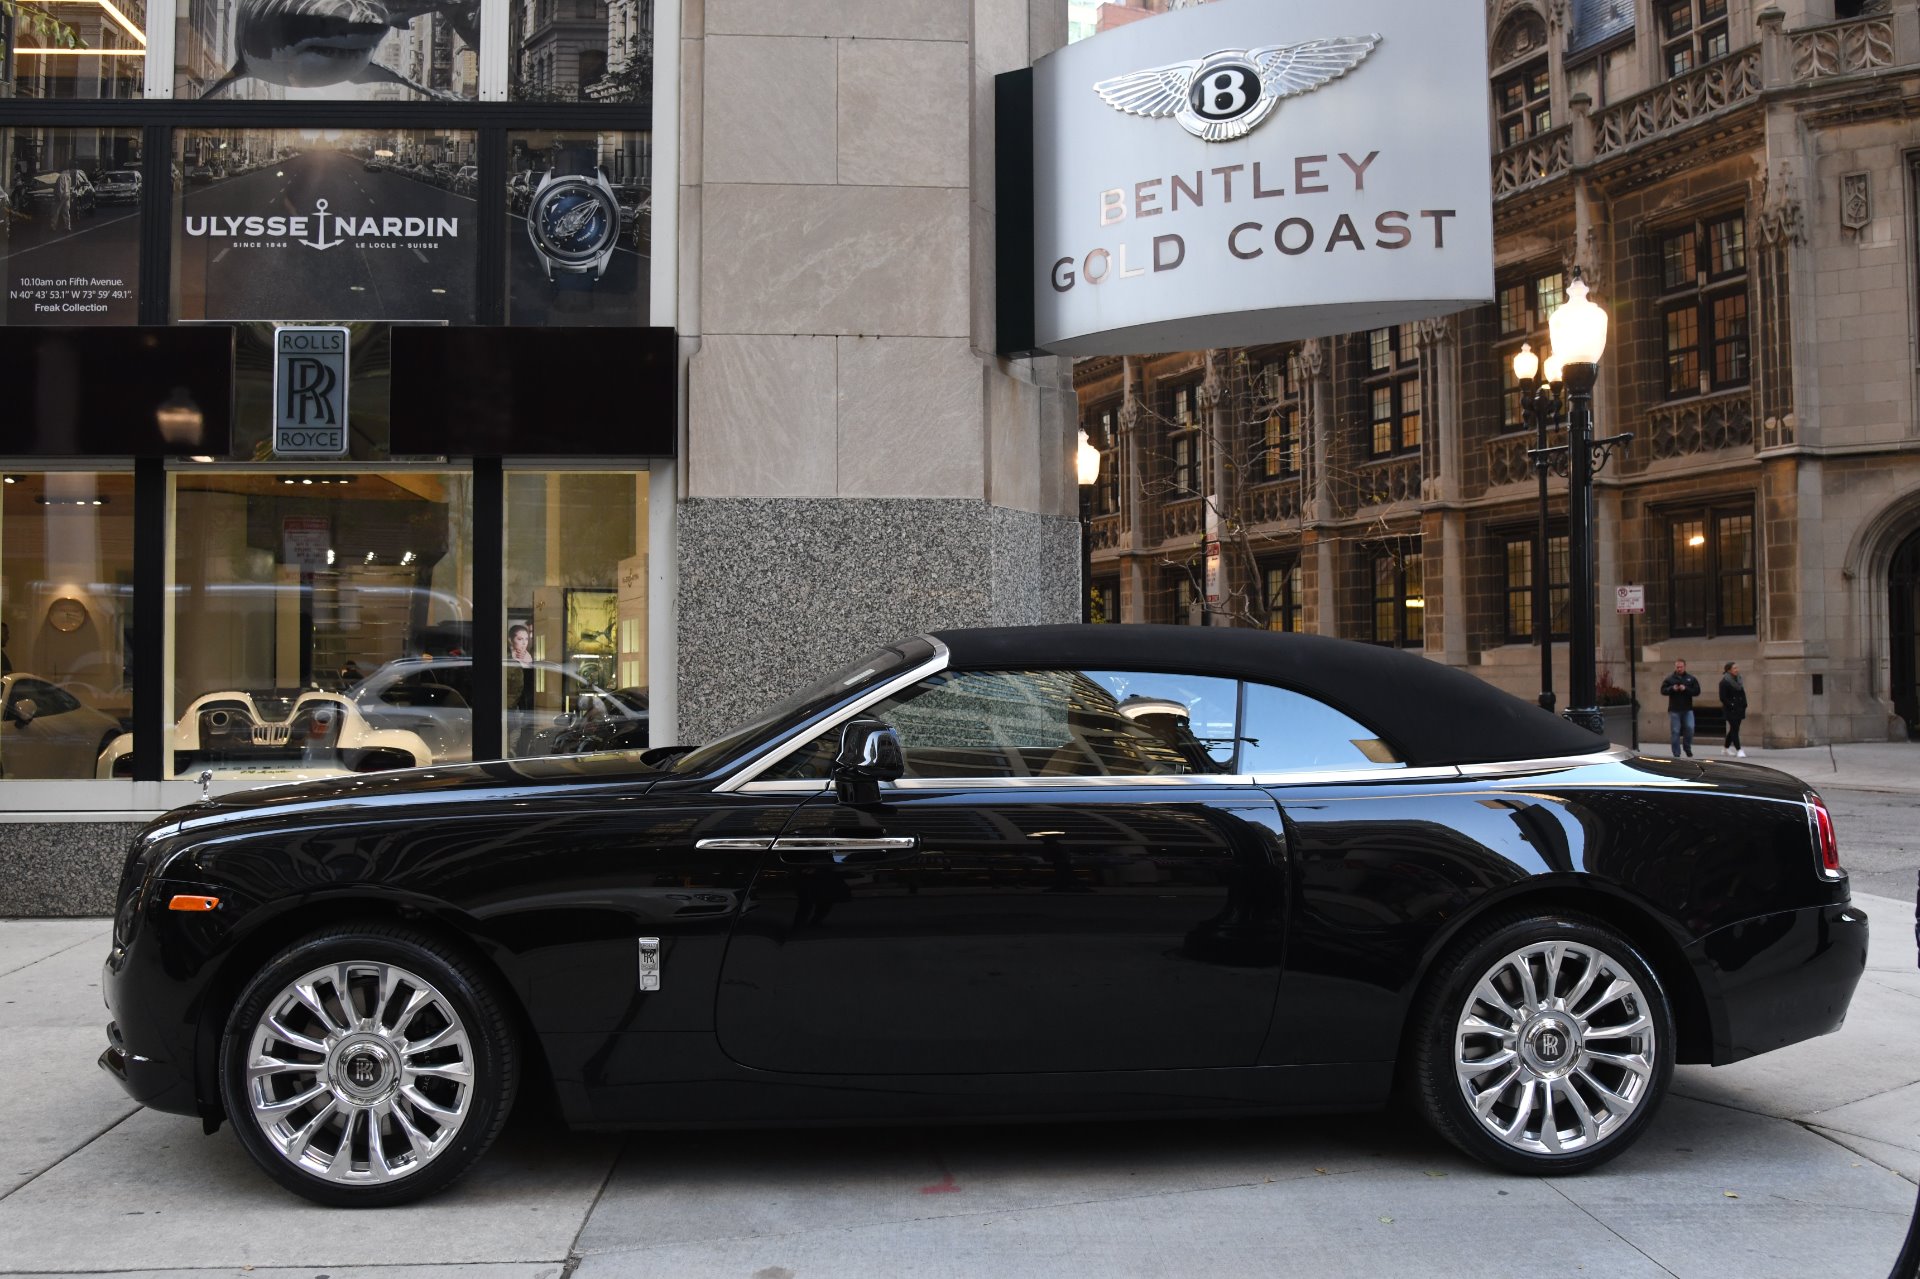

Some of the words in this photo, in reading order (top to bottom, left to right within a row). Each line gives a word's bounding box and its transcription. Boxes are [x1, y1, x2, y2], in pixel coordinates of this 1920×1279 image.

[1099, 150, 1380, 228] BENTLEY
[186, 216, 309, 236] ULYSSE
[335, 217, 459, 237] NARDIN
[1050, 233, 1186, 293] GOLD
[1228, 209, 1457, 260] COAST
[20, 278, 54, 286] 10.10am
[69, 277, 88, 286] Fifth
[90, 278, 124, 286] Avenue.
[10, 291, 18, 299] N
[71, 291, 80, 299] W
[34, 303, 60, 312] Freak
[62, 303, 108, 312] Collection
[283, 335, 340, 350] ROLLS
[286, 357, 337, 425] RR
[281, 432, 339, 447] ROYCE
[1542, 1033, 1559, 1056] RR
